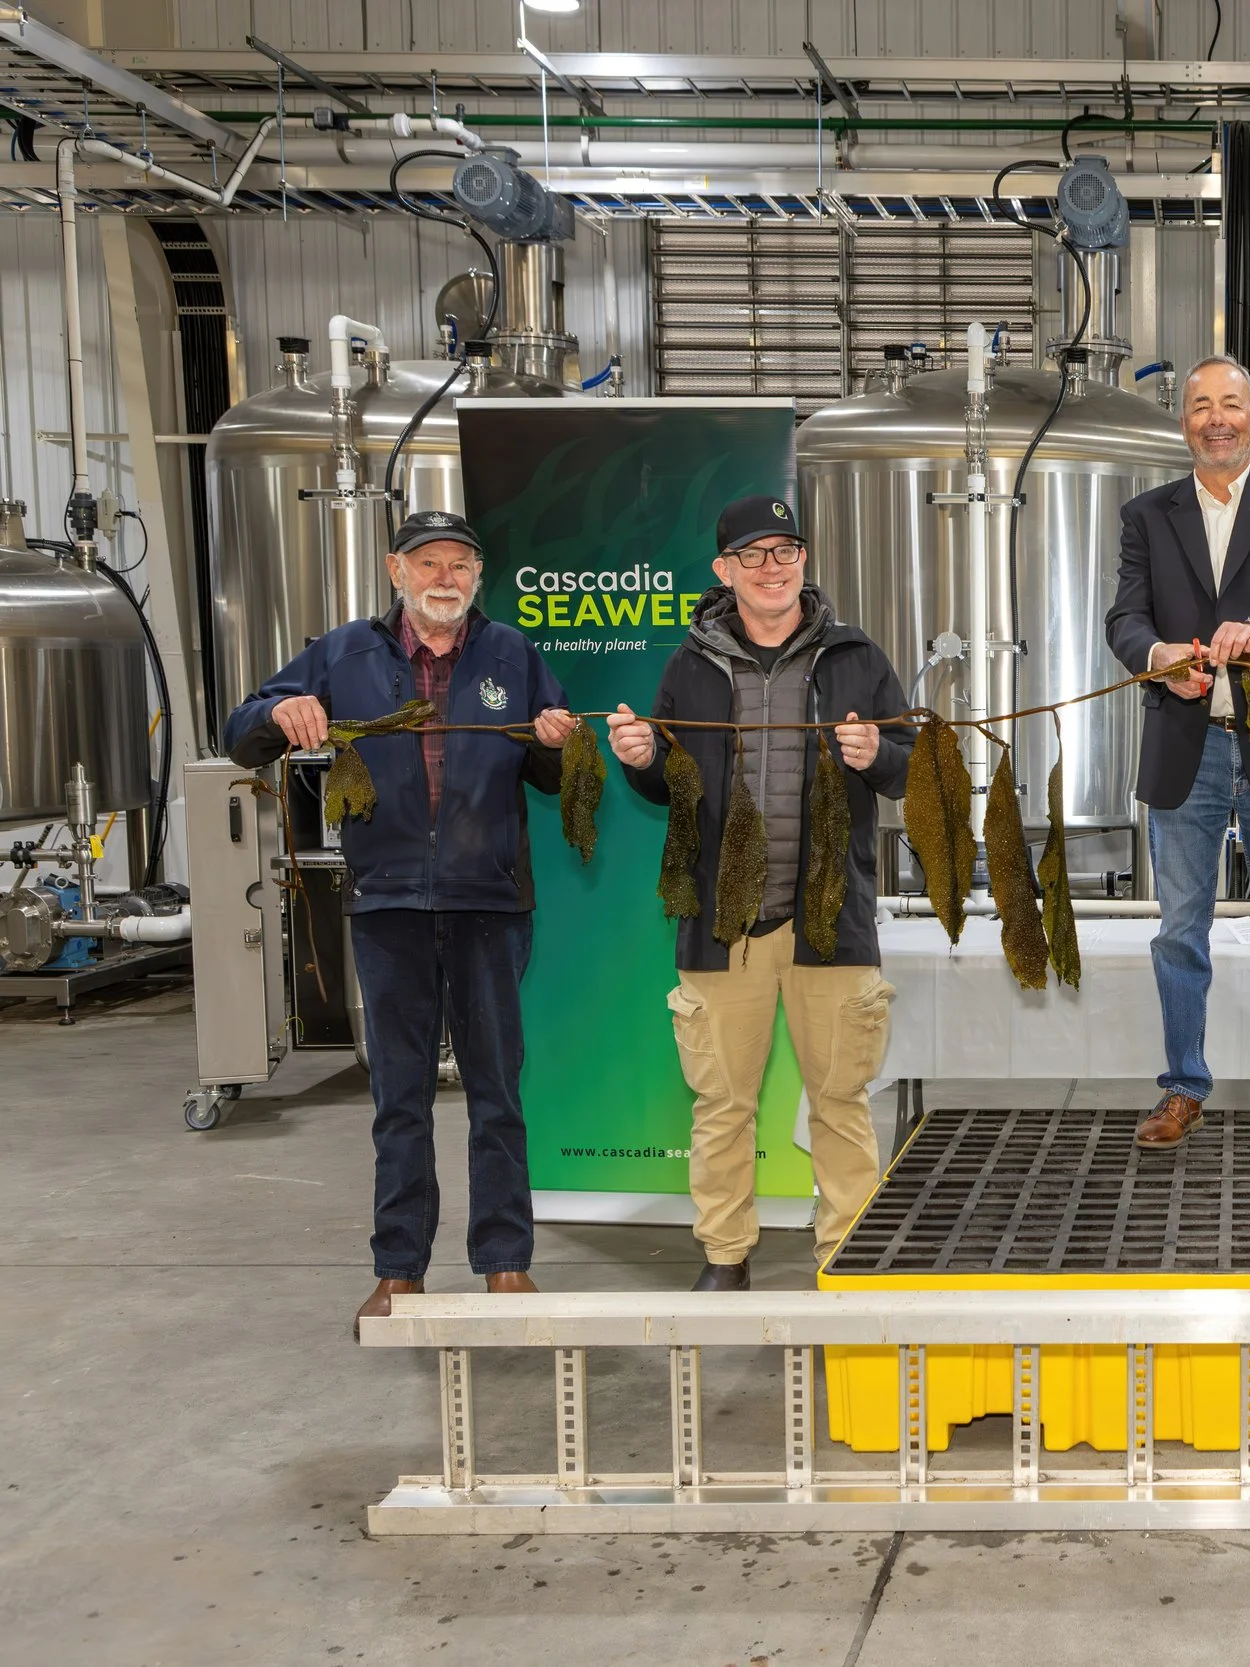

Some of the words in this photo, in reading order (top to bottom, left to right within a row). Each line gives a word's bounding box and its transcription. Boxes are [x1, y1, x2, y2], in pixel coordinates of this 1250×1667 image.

[515, 563, 674, 593] Cascadia
[517, 593, 703, 628] SEAWEE
[543, 642, 552, 651] a
[554, 638, 603, 654] healthy
[604, 638, 648, 654] planet
[560, 1146, 766, 1159] www.cascadiaseam
